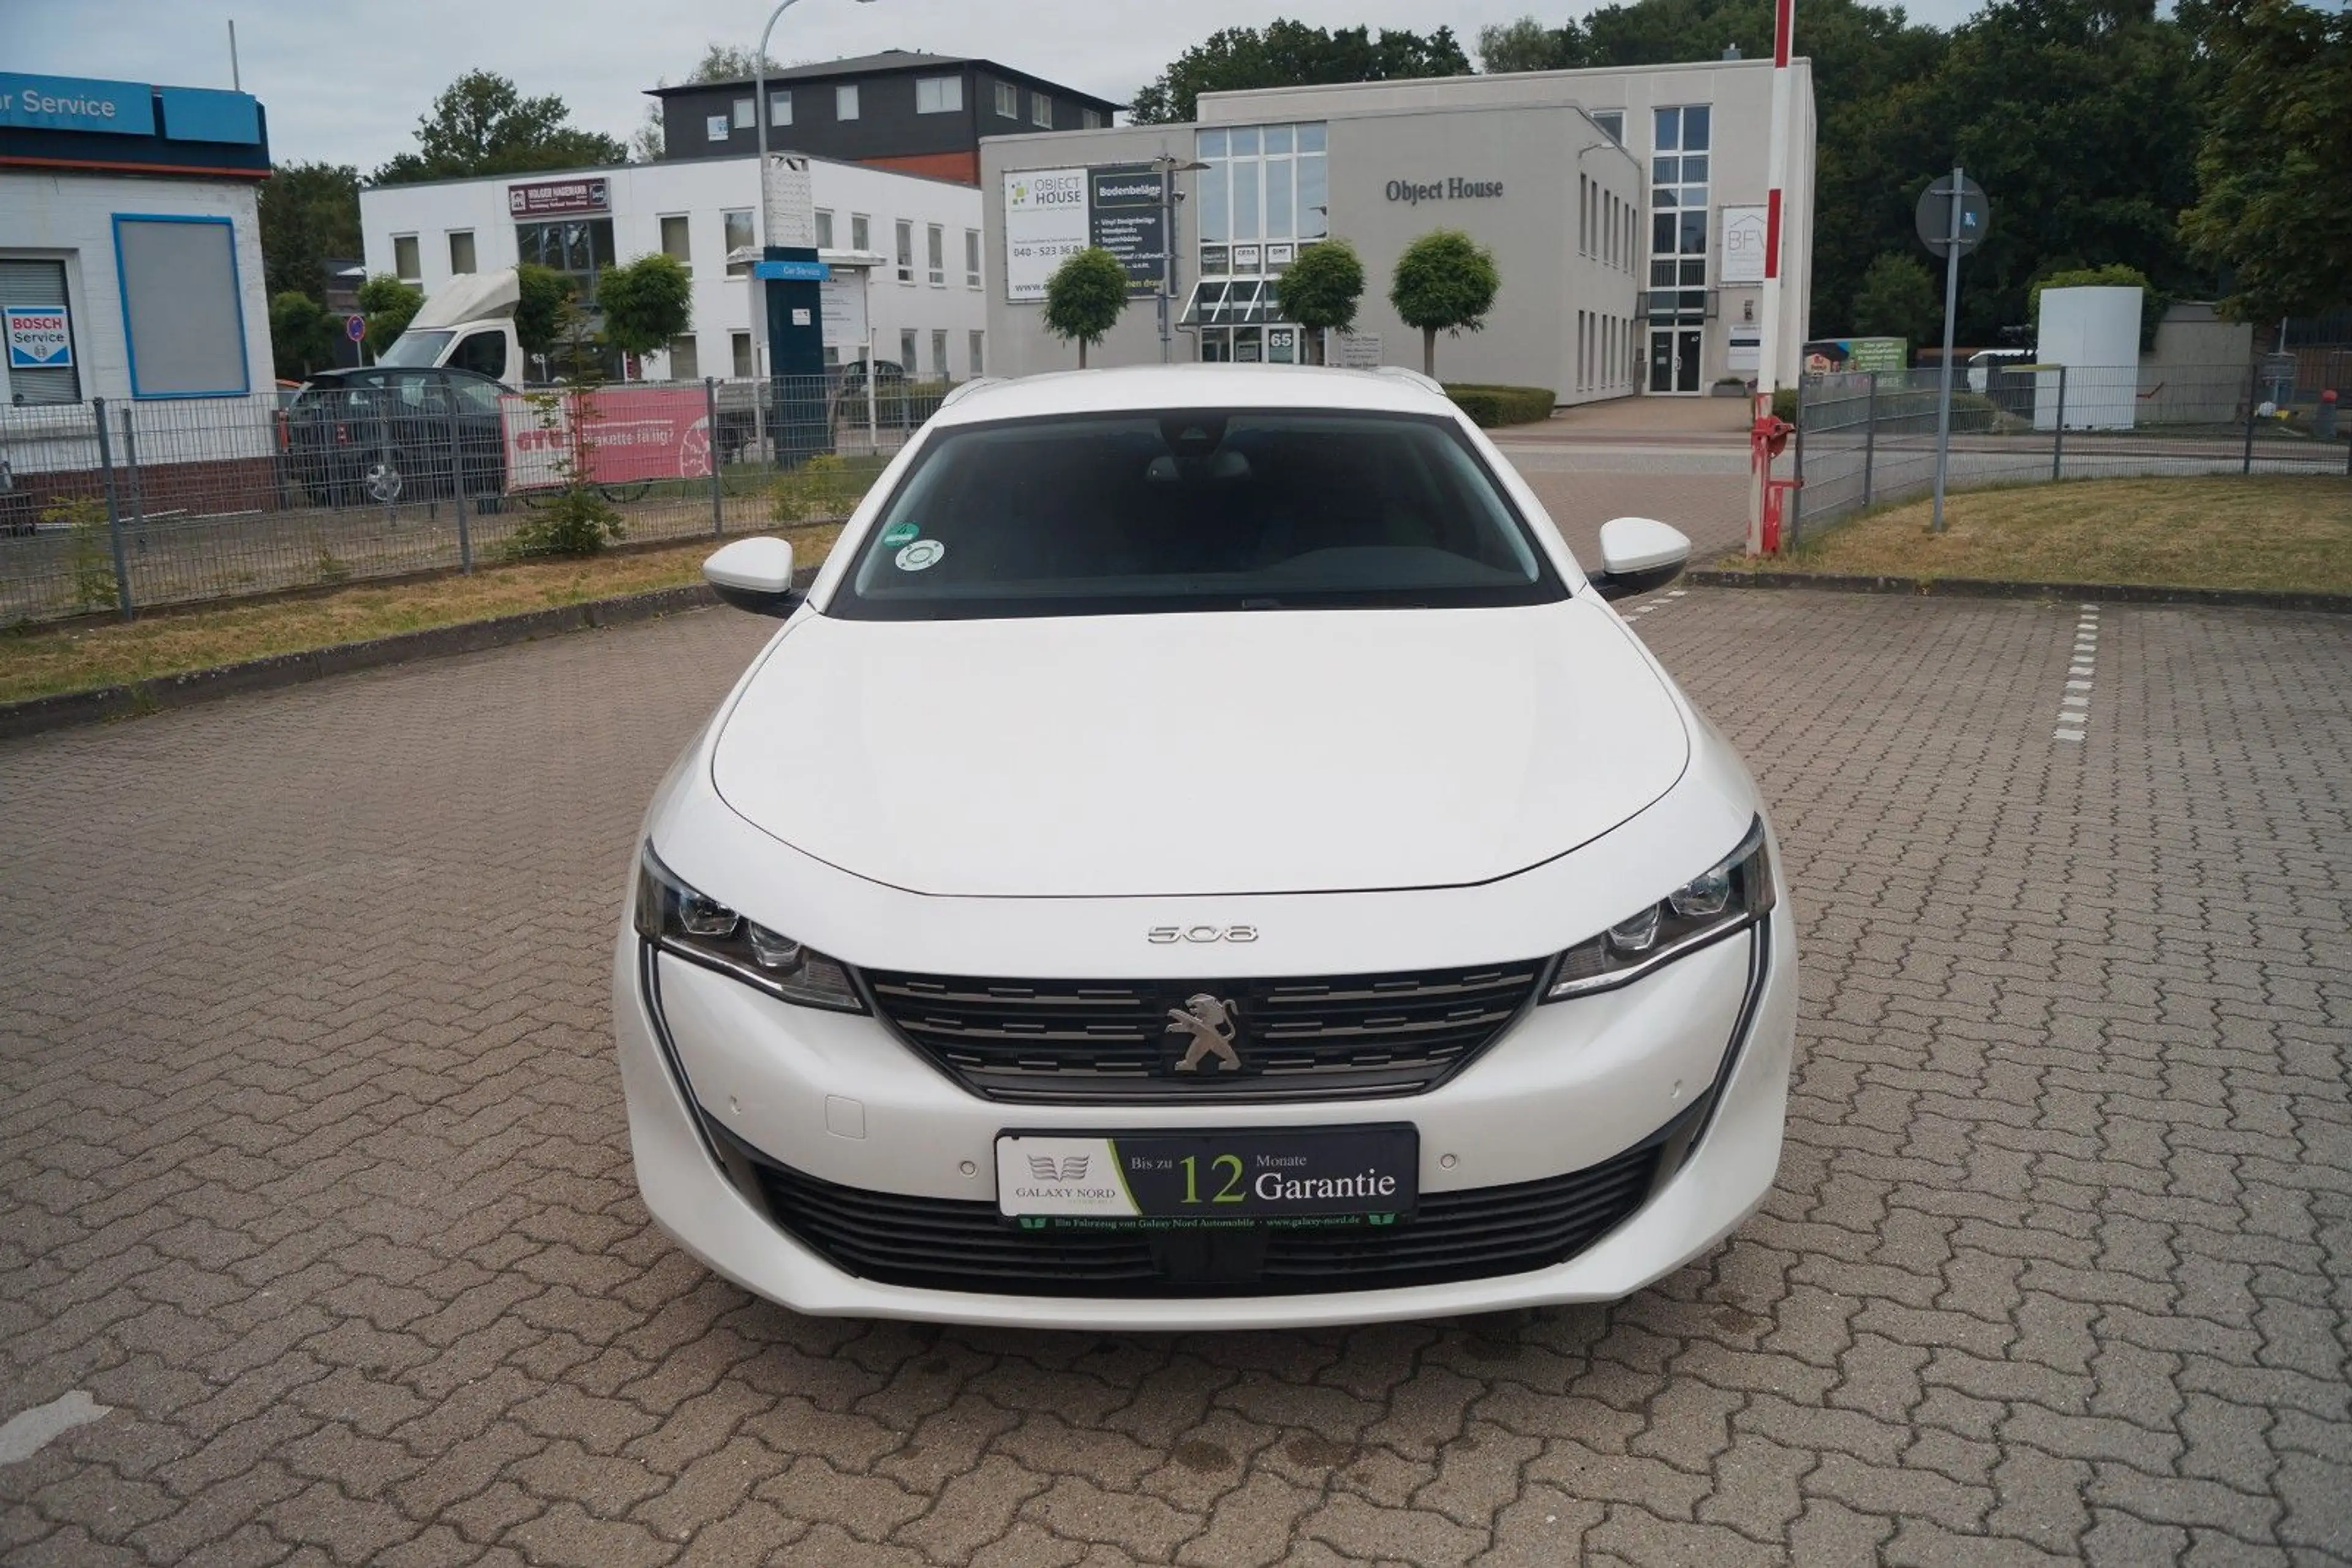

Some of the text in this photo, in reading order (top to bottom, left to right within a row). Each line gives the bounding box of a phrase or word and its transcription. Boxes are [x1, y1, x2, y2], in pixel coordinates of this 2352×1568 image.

[0, 89, 116, 117] r Service
[1035, 176, 1080, 192] OBJECT
[1385, 176, 1504, 206] Object House
[1036, 190, 1081, 205] HOUSE
[1039, 246, 1057, 256] 523
[13, 317, 62, 330] BOSCH
[14, 331, 64, 343] Service
[1270, 333, 1292, 347] 65
[1147, 925, 1259, 944] 508
[1131, 1154, 1307, 1203] Bis zu 12 Monate
[1255, 1168, 1396, 1200] Garantie
[1016, 1187, 1115, 1198] GALAXY NORD
[1055, 1218, 1071, 1227] Ein
[1074, 1218, 1117, 1229] Fahrzeug
[1139, 1219, 1171, 1229] Galaxy
[1173, 1219, 1197, 1227] Nord
[1200, 1218, 1254, 1227] Automobile
[1267, 1215, 1360, 1228] www.galaxy-nord.de
